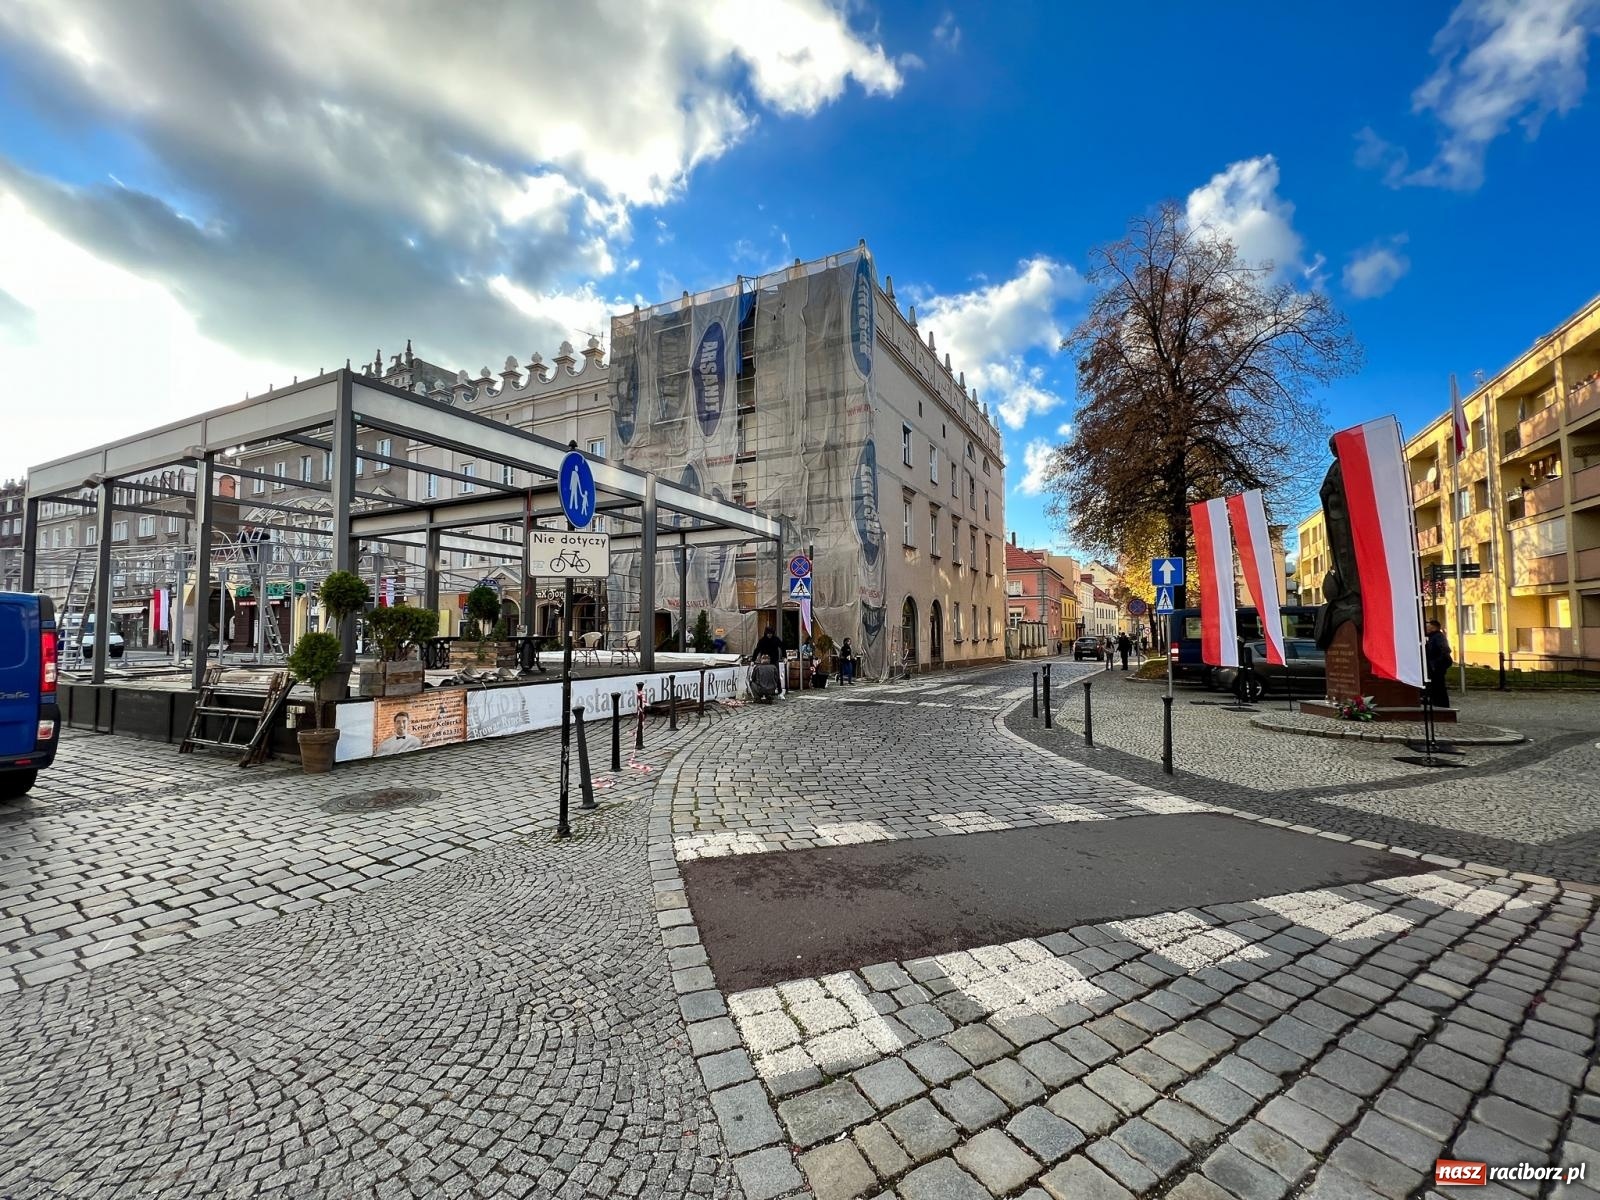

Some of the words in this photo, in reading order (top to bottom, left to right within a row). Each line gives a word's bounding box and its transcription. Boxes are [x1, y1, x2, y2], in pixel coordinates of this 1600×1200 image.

[699, 340, 720, 414] ARSANIT
[533, 533, 555, 544] Nie
[560, 534, 607, 549] dotyczy
[707, 670, 738, 698] Rynek
